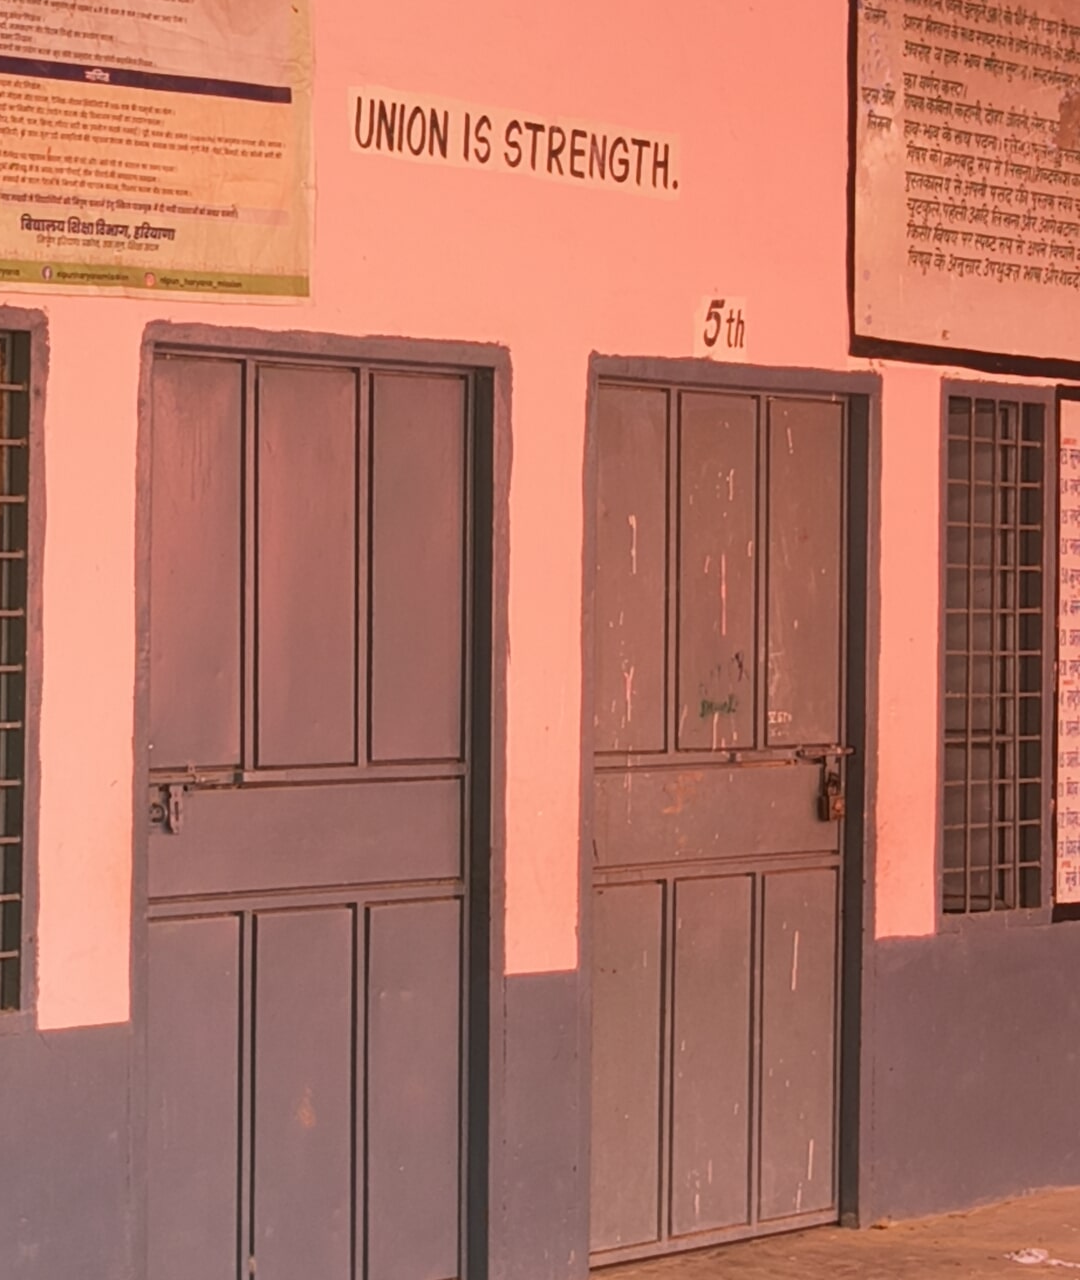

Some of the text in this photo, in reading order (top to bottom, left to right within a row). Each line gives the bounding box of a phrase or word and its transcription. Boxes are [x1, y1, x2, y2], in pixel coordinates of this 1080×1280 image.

[354, 96, 449, 159] UNION
[464, 113, 491, 164] IS
[504, 119, 679, 190] STRENGTH.
[20, 213, 64, 232] विद्यालय
[67, 216, 93, 234] शिक्षा
[134, 222, 175, 240] हरियाणा
[703, 299, 745, 349] 5th
